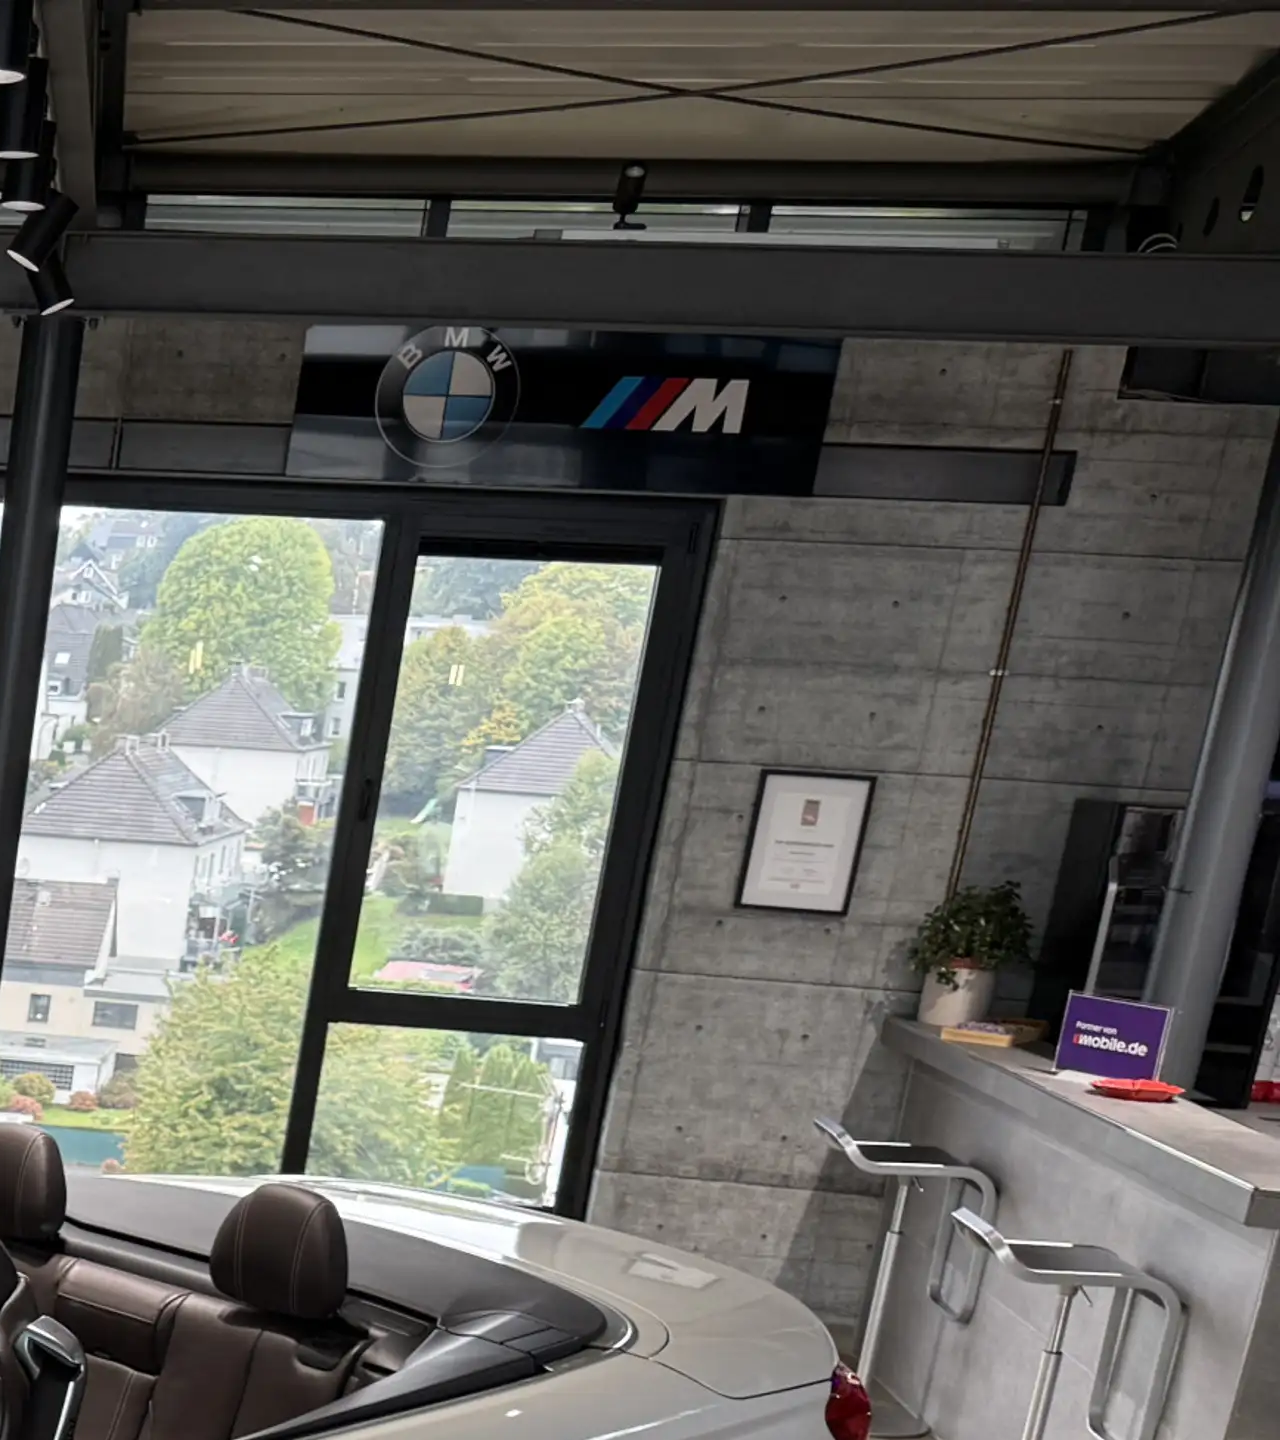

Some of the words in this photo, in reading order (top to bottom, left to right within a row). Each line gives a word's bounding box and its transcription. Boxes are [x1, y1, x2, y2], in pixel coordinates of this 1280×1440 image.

[396, 326, 512, 373] BMW
[650, 378, 750, 434] M
[1073, 1034, 1148, 1057] mobile.de
